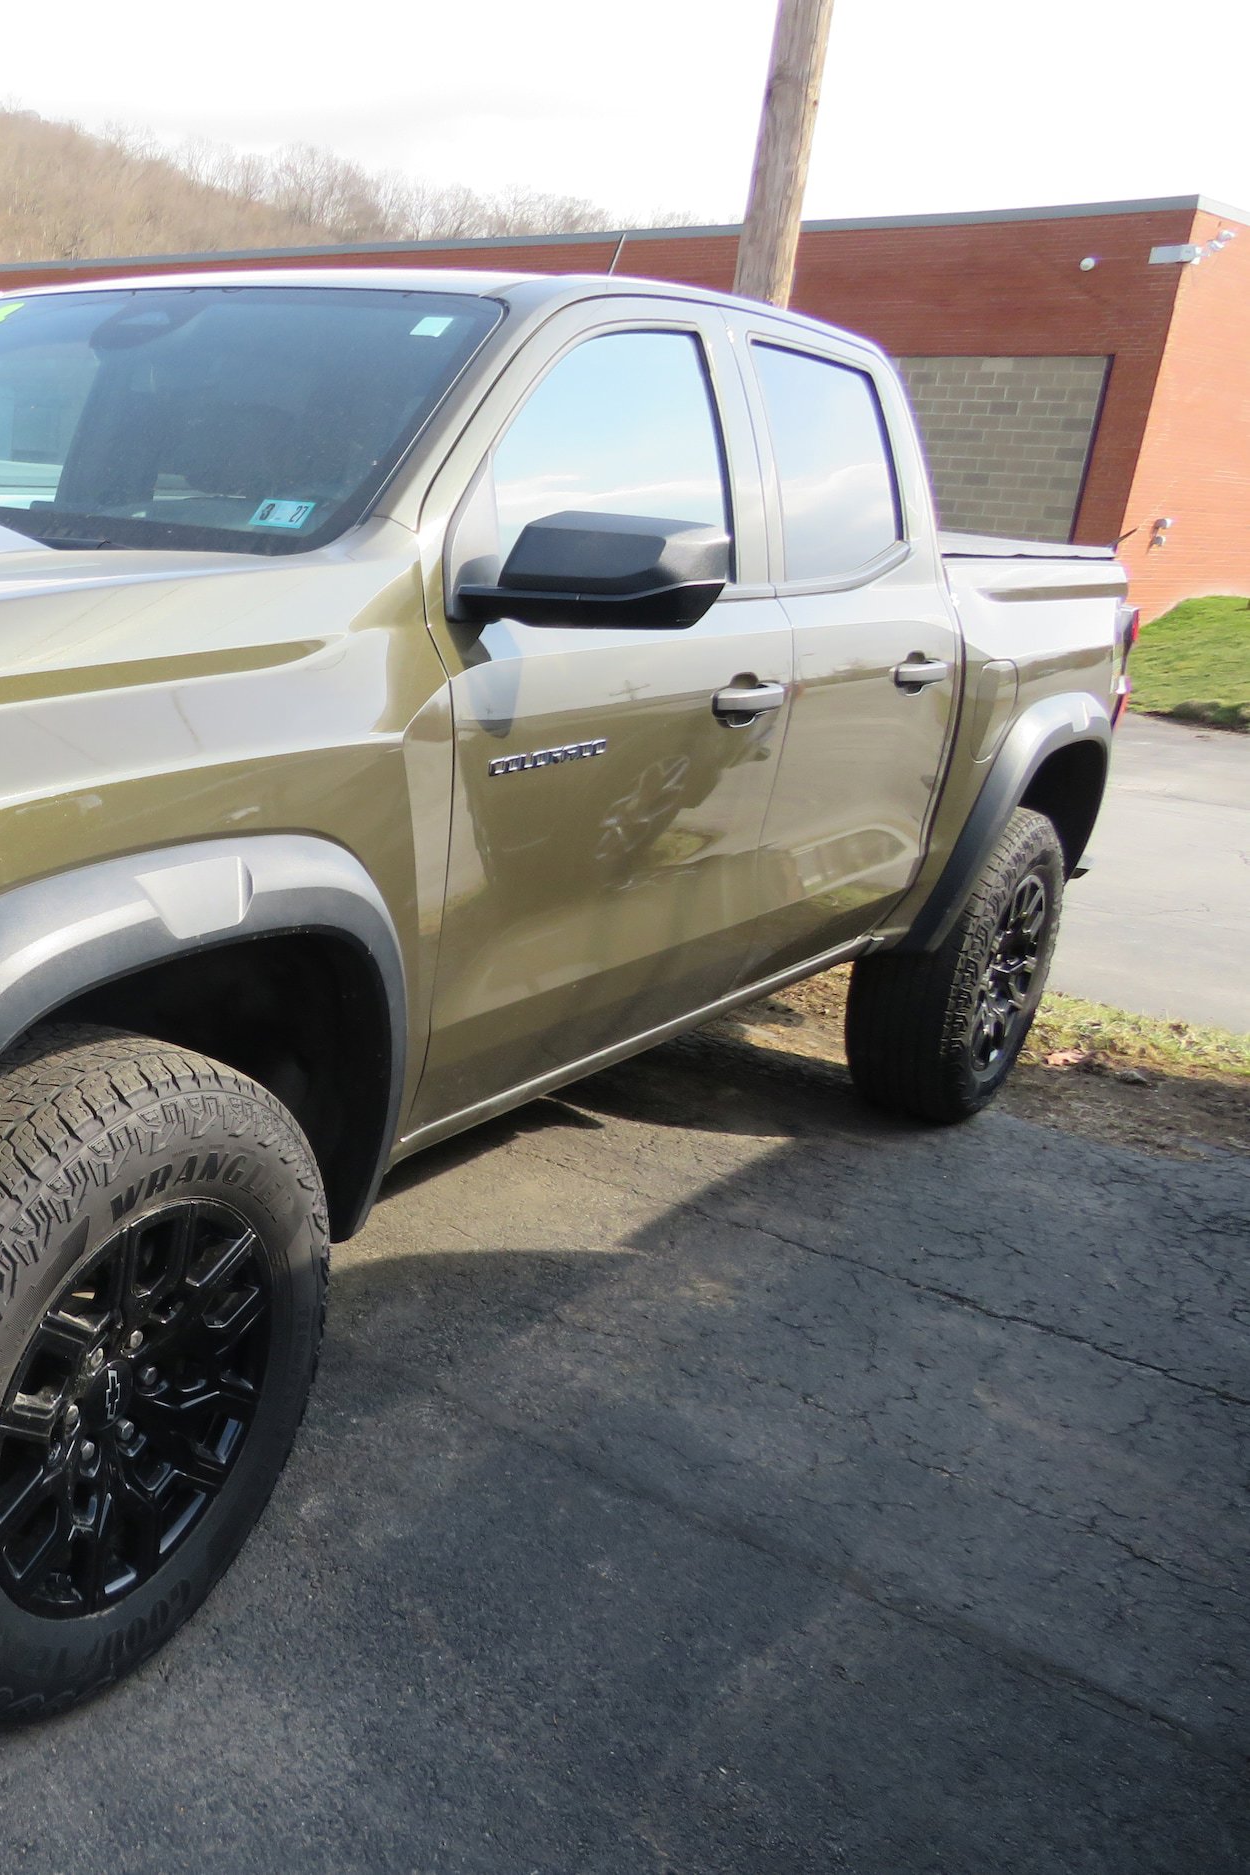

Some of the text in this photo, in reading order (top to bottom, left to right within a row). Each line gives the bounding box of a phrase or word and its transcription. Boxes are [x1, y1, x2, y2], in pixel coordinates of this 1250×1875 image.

[259, 503, 310, 524] 3 27
[488, 739, 606, 777] COLORADO
[110, 1151, 296, 1224] WRANGLER
